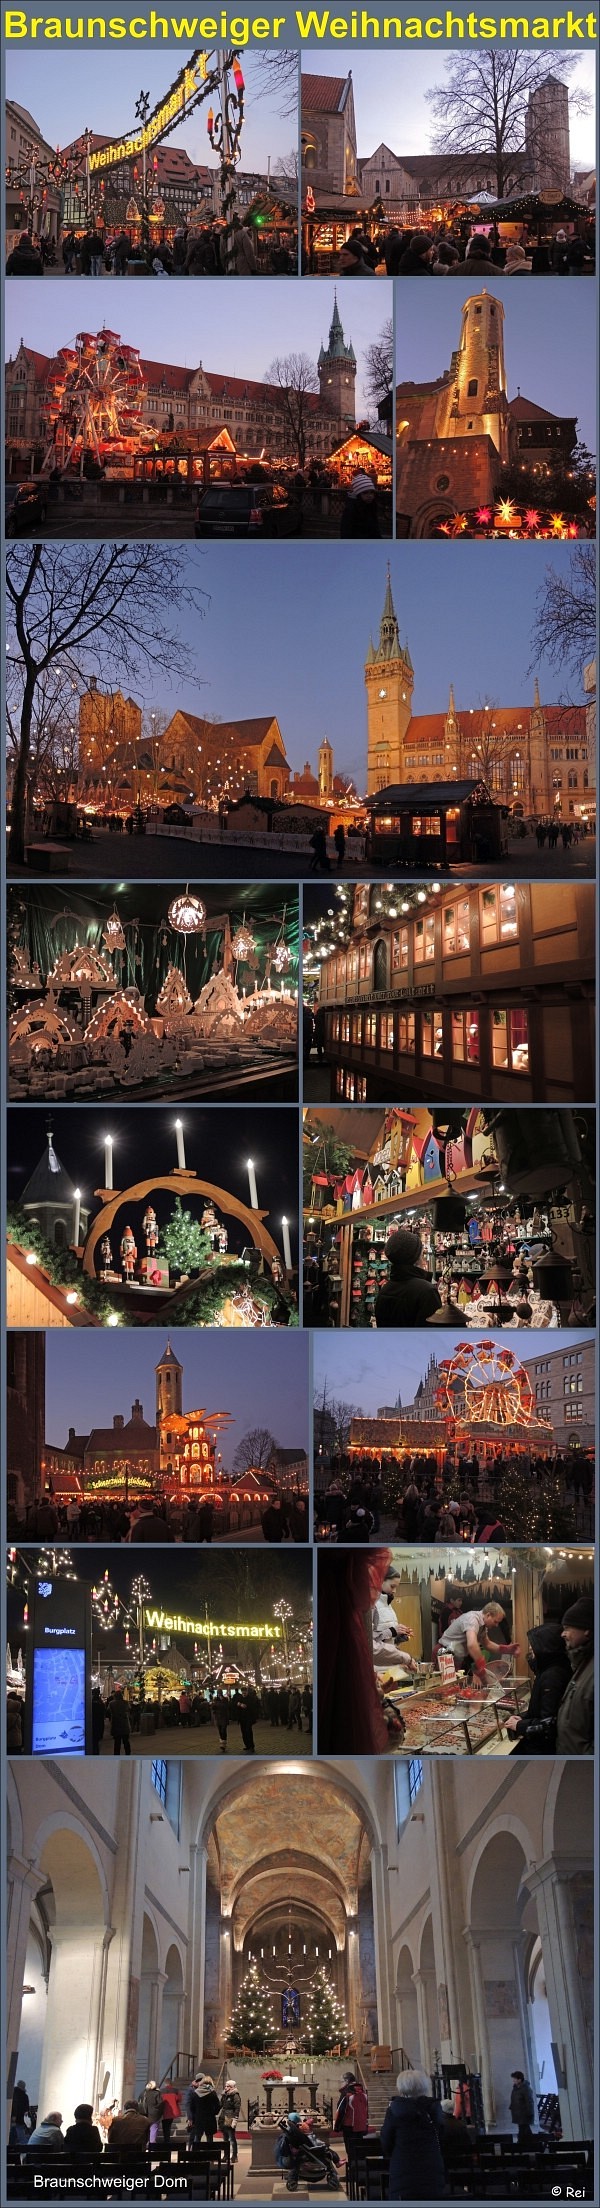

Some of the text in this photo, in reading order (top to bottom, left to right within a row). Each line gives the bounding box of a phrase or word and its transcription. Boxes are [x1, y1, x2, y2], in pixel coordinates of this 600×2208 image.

[550, 1208, 570, 1220] 133
[145, 1609, 281, 1638] Weihnachtsmarkt
[44, 1627, 76, 1635] Burgplatz
